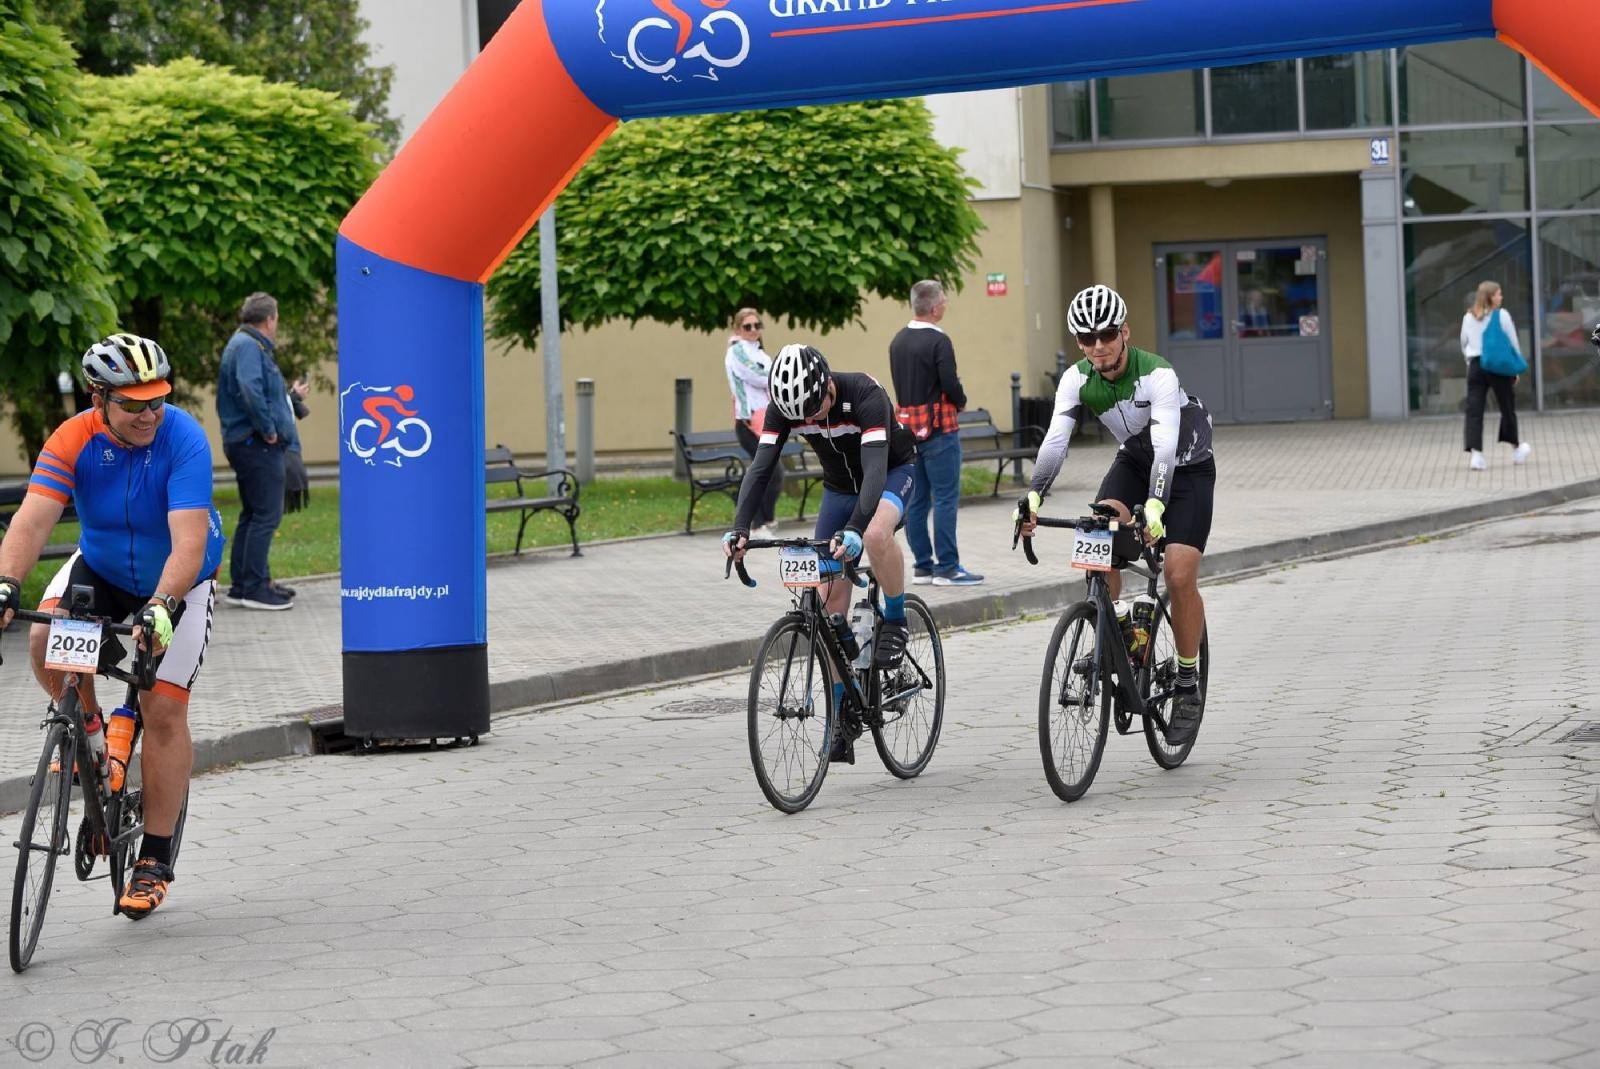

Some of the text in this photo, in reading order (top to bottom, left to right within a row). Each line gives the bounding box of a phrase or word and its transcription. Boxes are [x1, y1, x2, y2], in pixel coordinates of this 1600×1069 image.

[1371, 140, 1388, 158] 31
[1075, 540, 1111, 556] 2249
[784, 560, 817, 573] 2248
[51, 634, 98, 654] 2020
